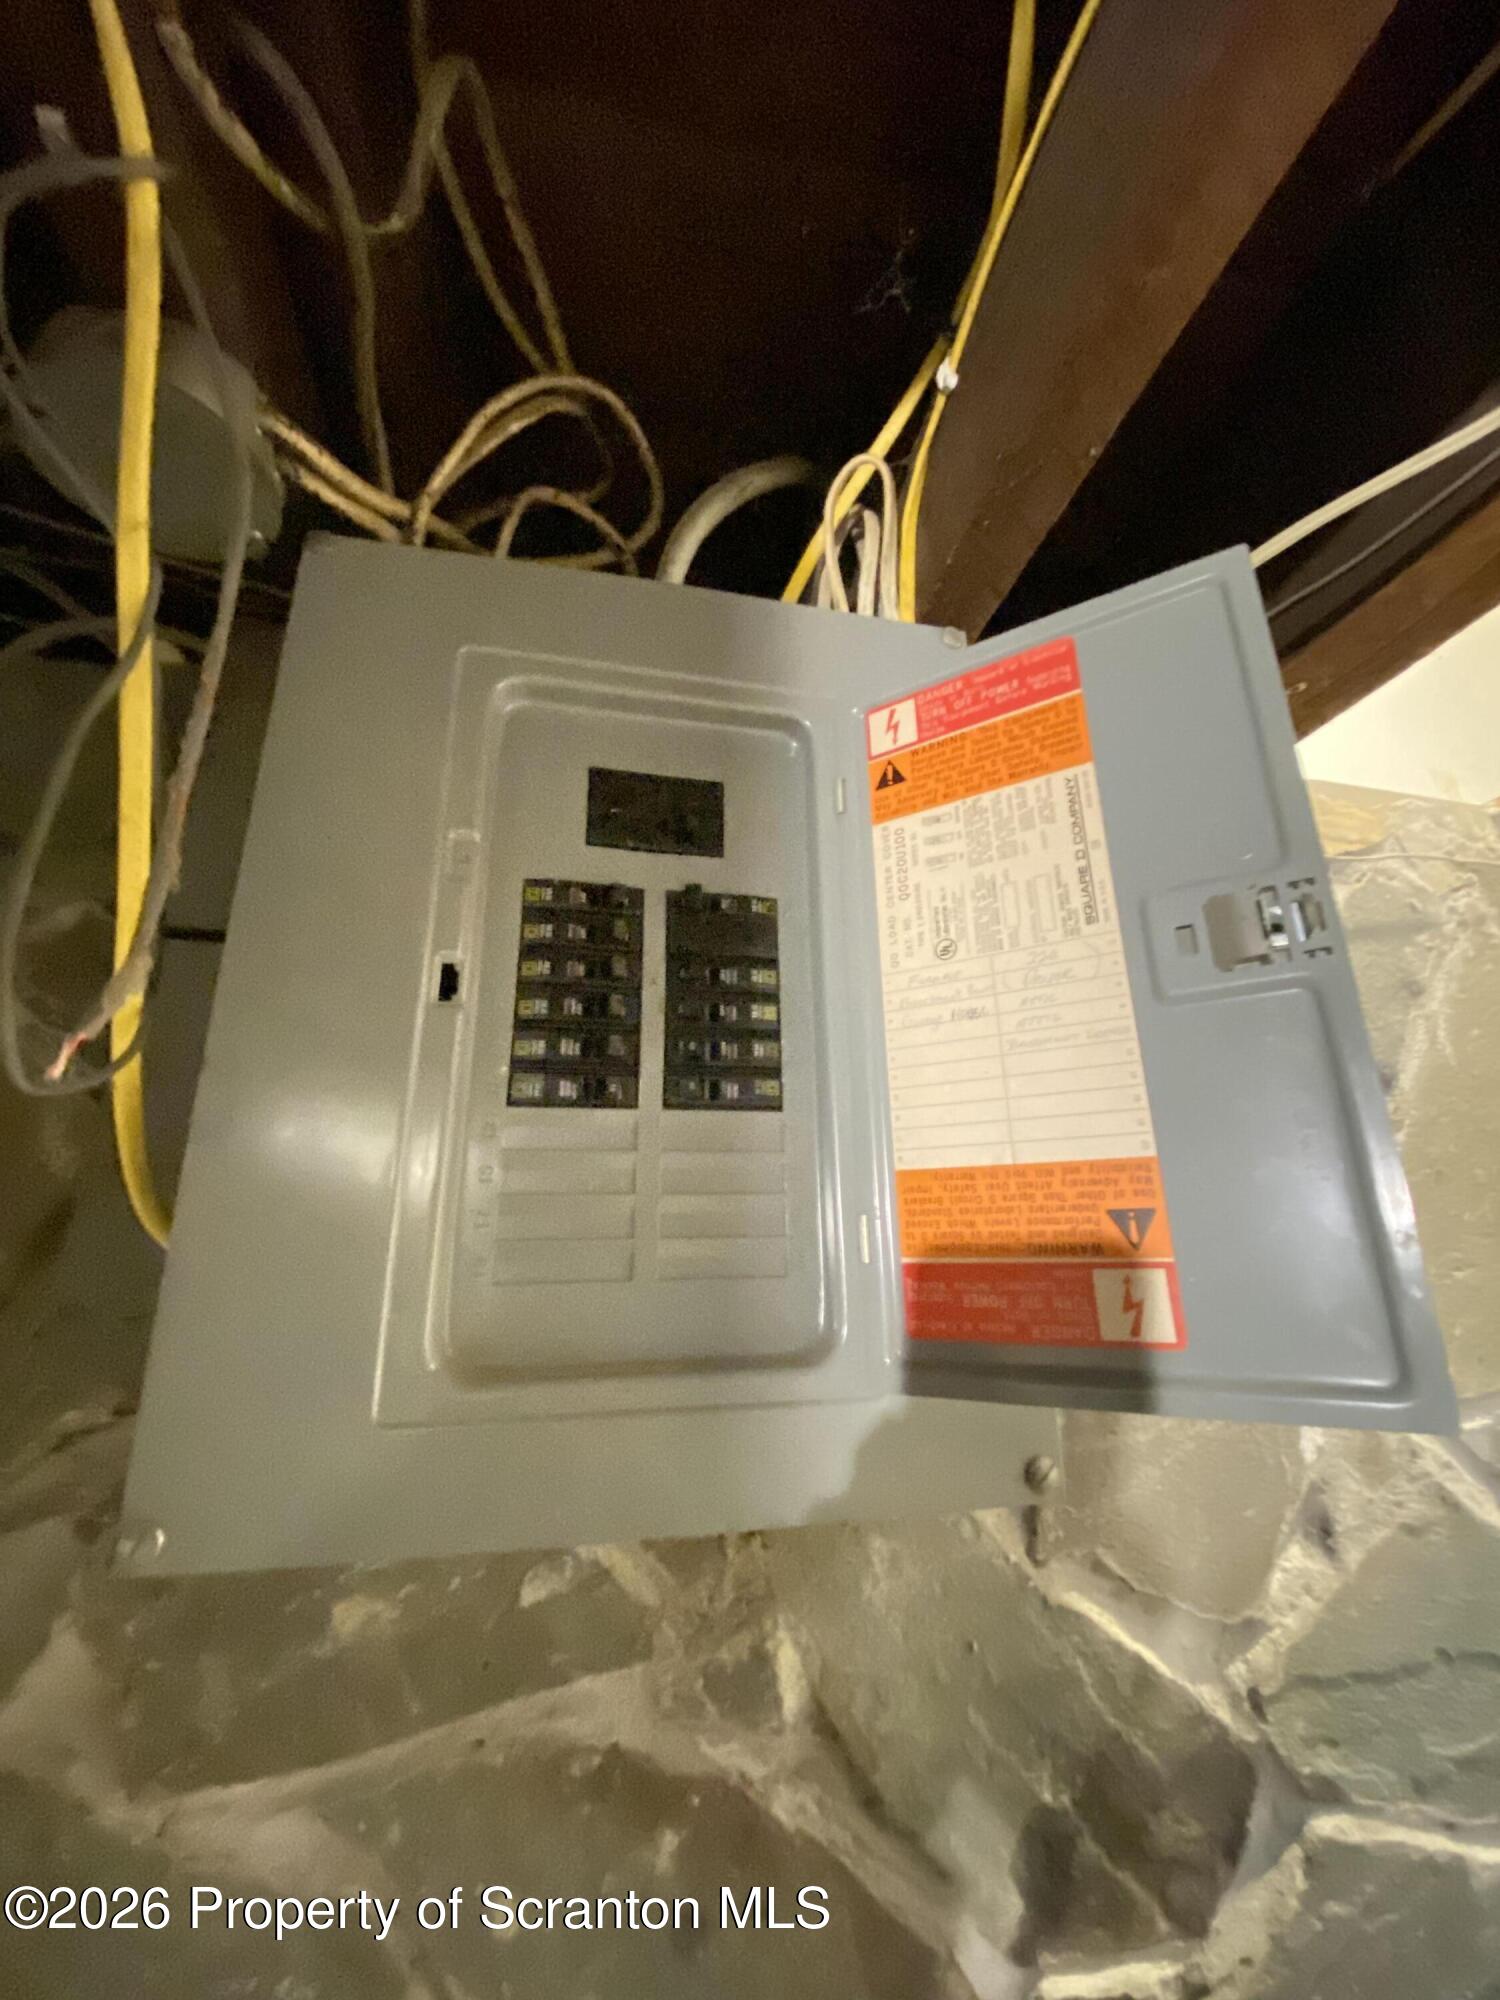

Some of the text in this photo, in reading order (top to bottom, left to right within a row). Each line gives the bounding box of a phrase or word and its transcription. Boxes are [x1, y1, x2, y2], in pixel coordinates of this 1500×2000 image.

[1062, 775, 1085, 845] COMPANY
[883, 864, 895, 909] CENTER
[1075, 864, 1098, 925] SQUARE
[887, 914, 897, 945] LOAD
